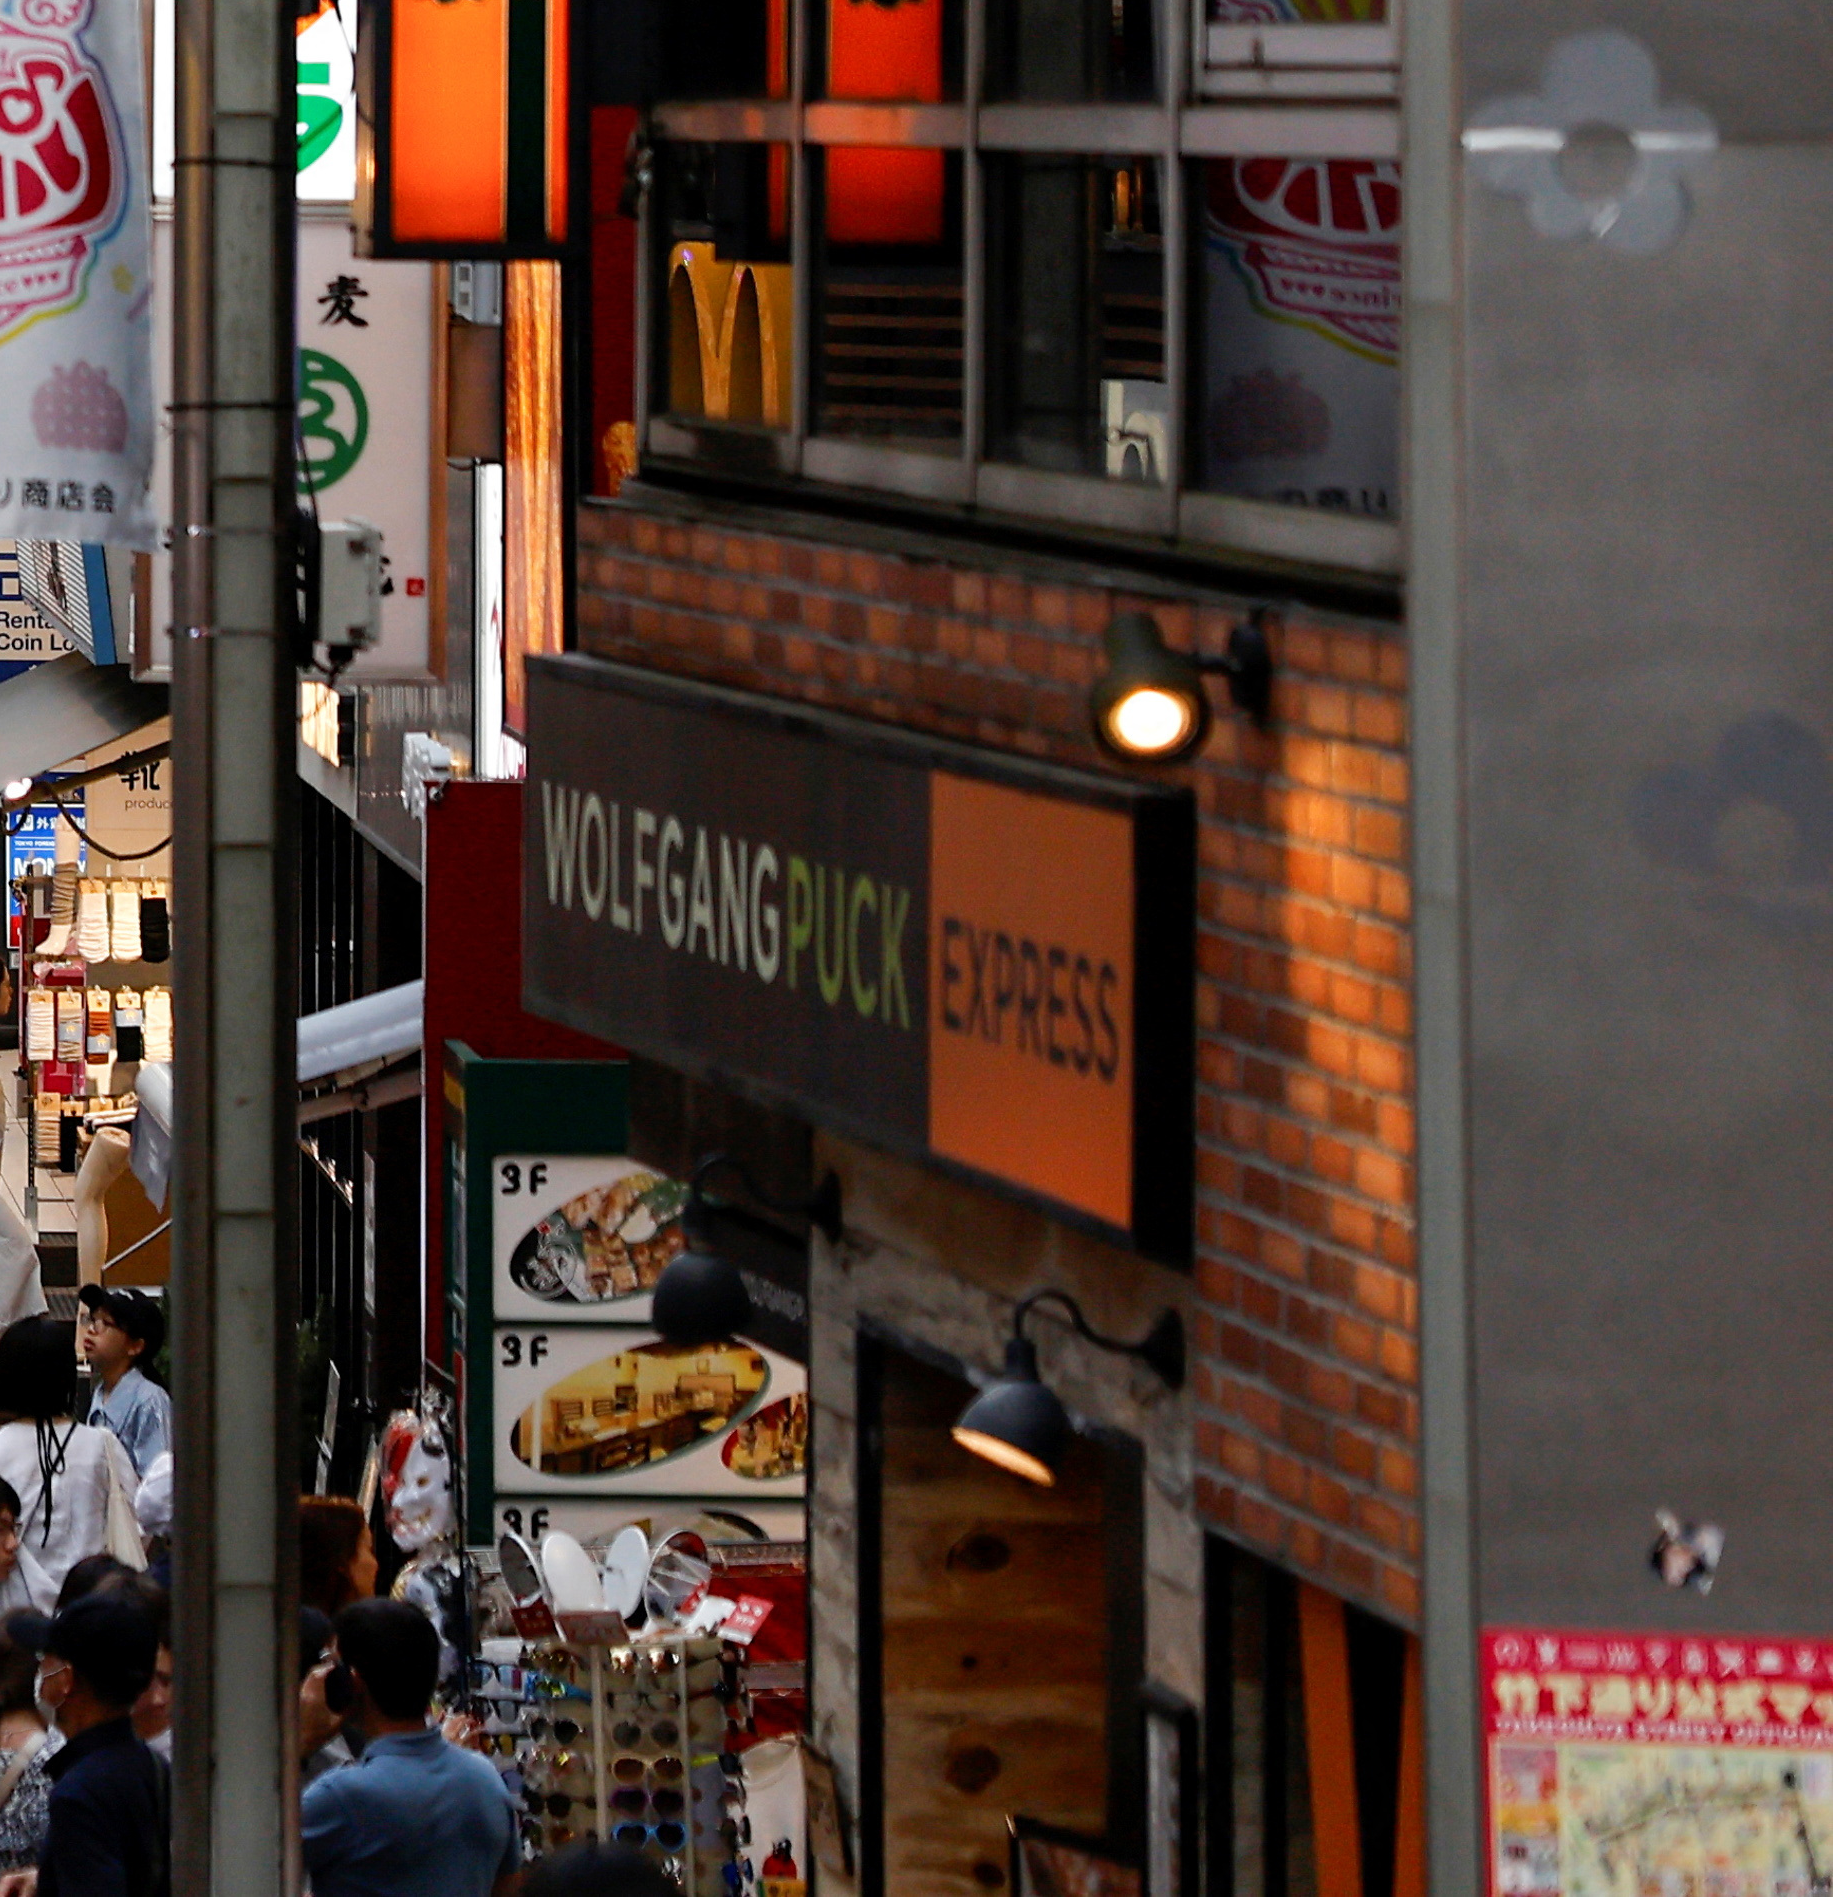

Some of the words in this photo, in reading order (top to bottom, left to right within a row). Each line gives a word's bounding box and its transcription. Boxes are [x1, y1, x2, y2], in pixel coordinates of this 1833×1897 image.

[124, 798, 172, 811] produc
[542, 780, 782, 985] WOLFGANG
[787, 853, 913, 1032] PUCK
[939, 916, 1122, 1088] EXPRESS
[500, 1163, 549, 1198] 3F
[500, 1333, 549, 1369] 3F
